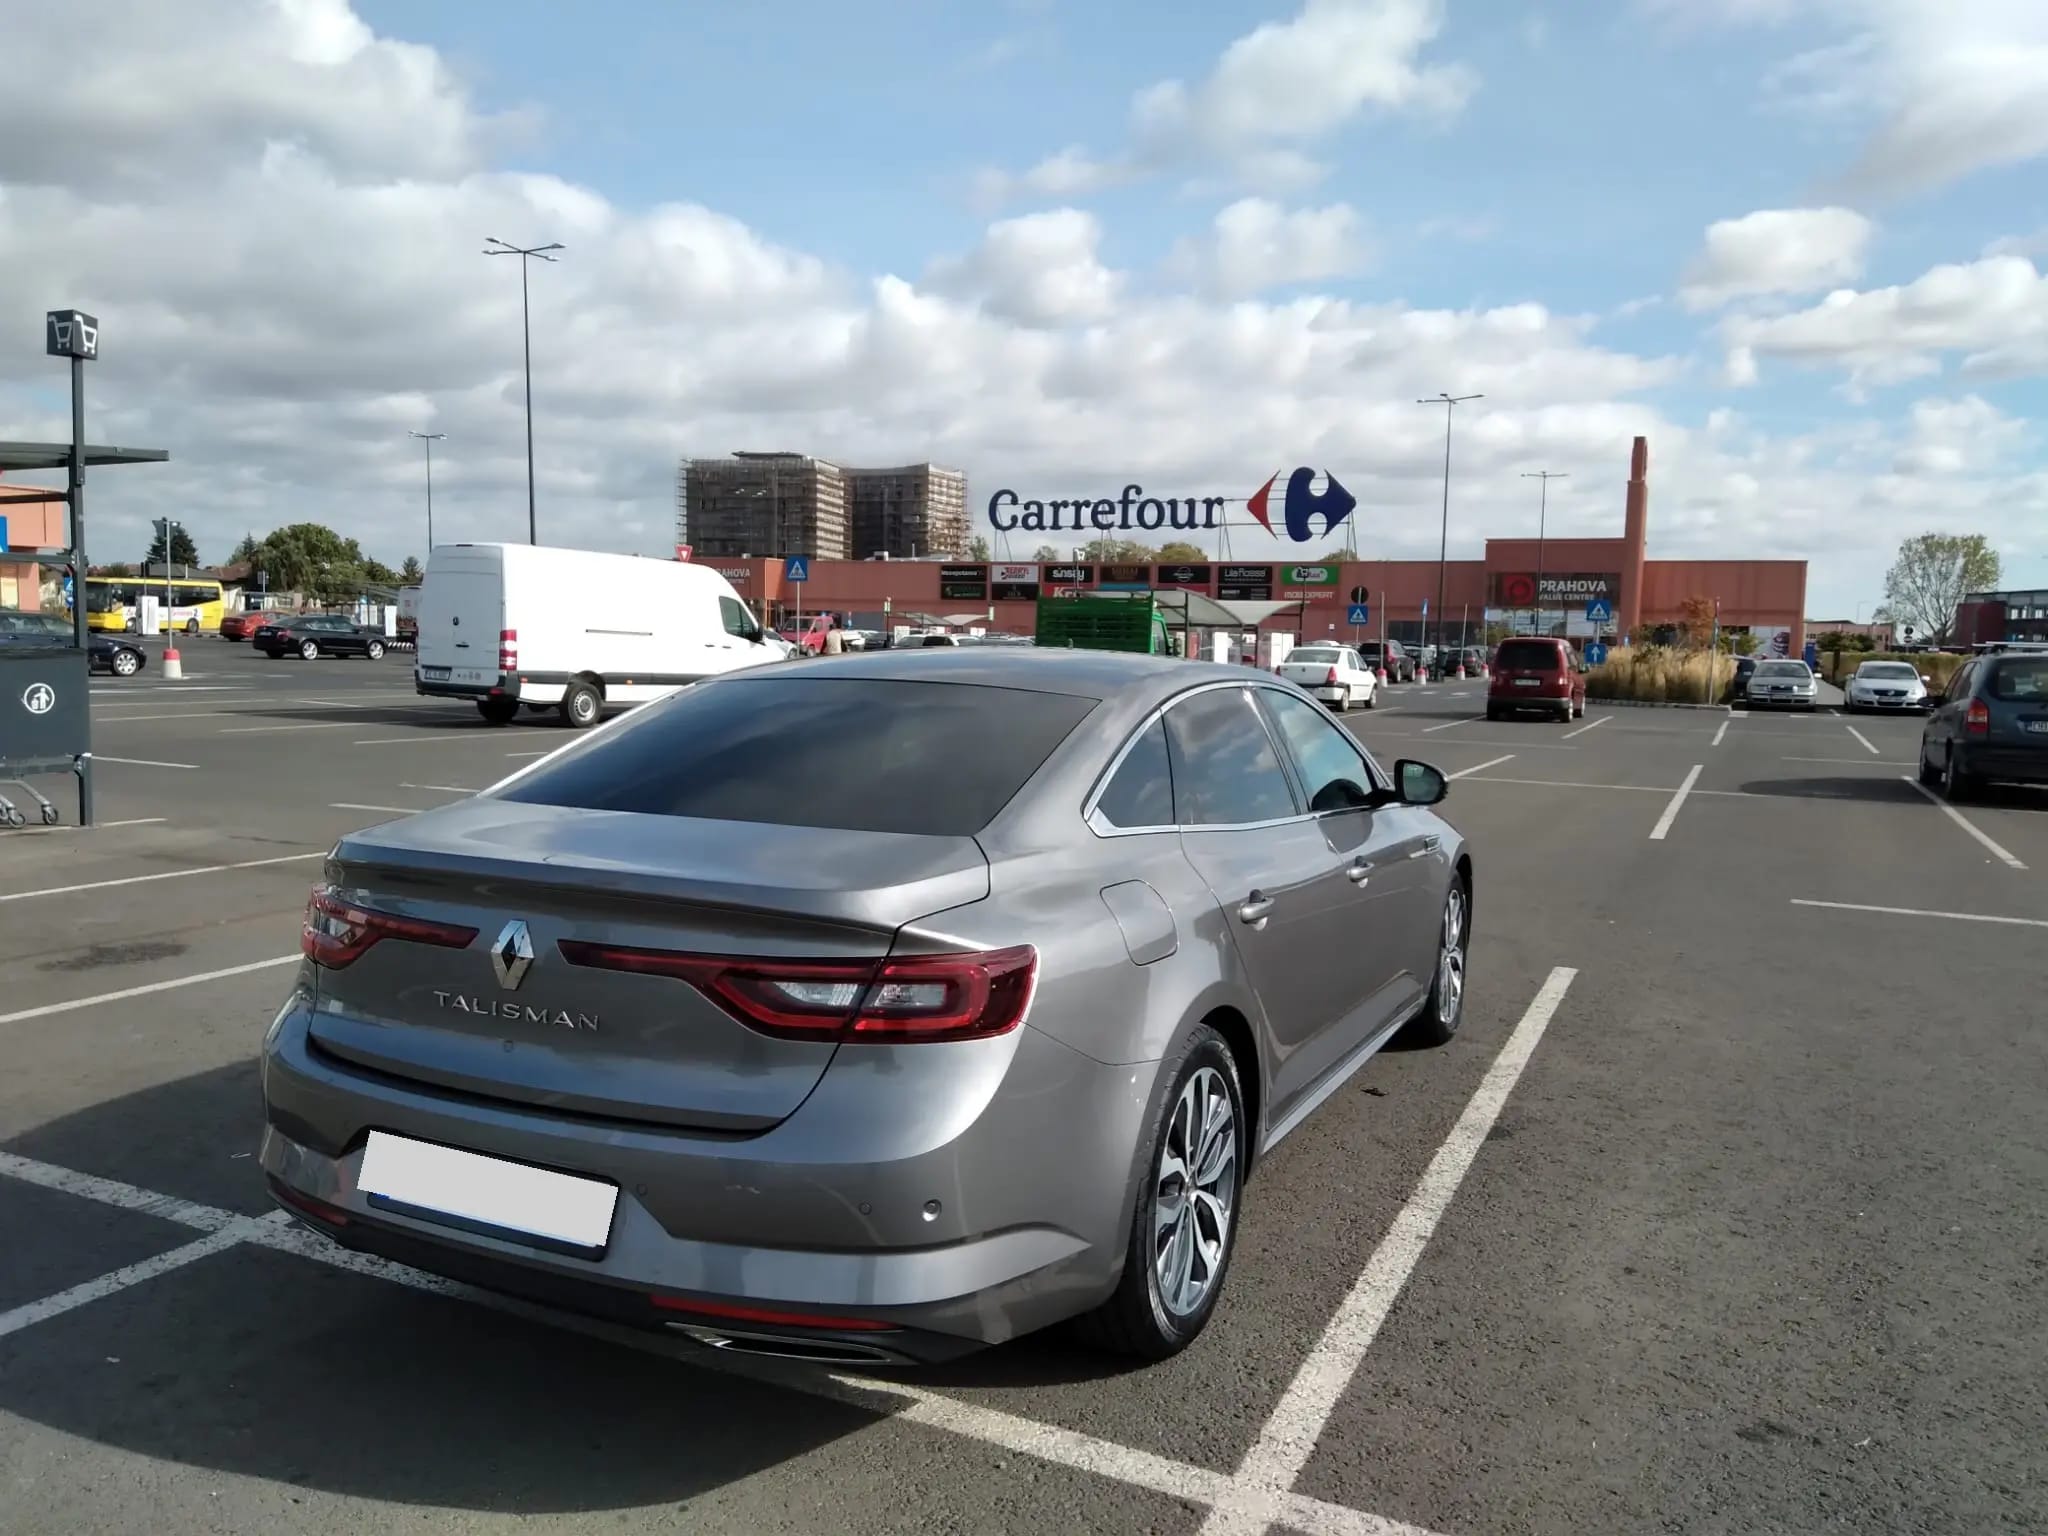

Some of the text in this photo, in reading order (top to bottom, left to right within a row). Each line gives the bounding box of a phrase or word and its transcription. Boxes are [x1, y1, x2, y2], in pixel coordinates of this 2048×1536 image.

[988, 484, 1224, 531] Carrefour
[716, 568, 751, 578] AHOVA
[1539, 580, 1607, 592] PRAHOVA
[1539, 593, 1562, 601] VALUE
[433, 990, 600, 1032] TALISMAN
